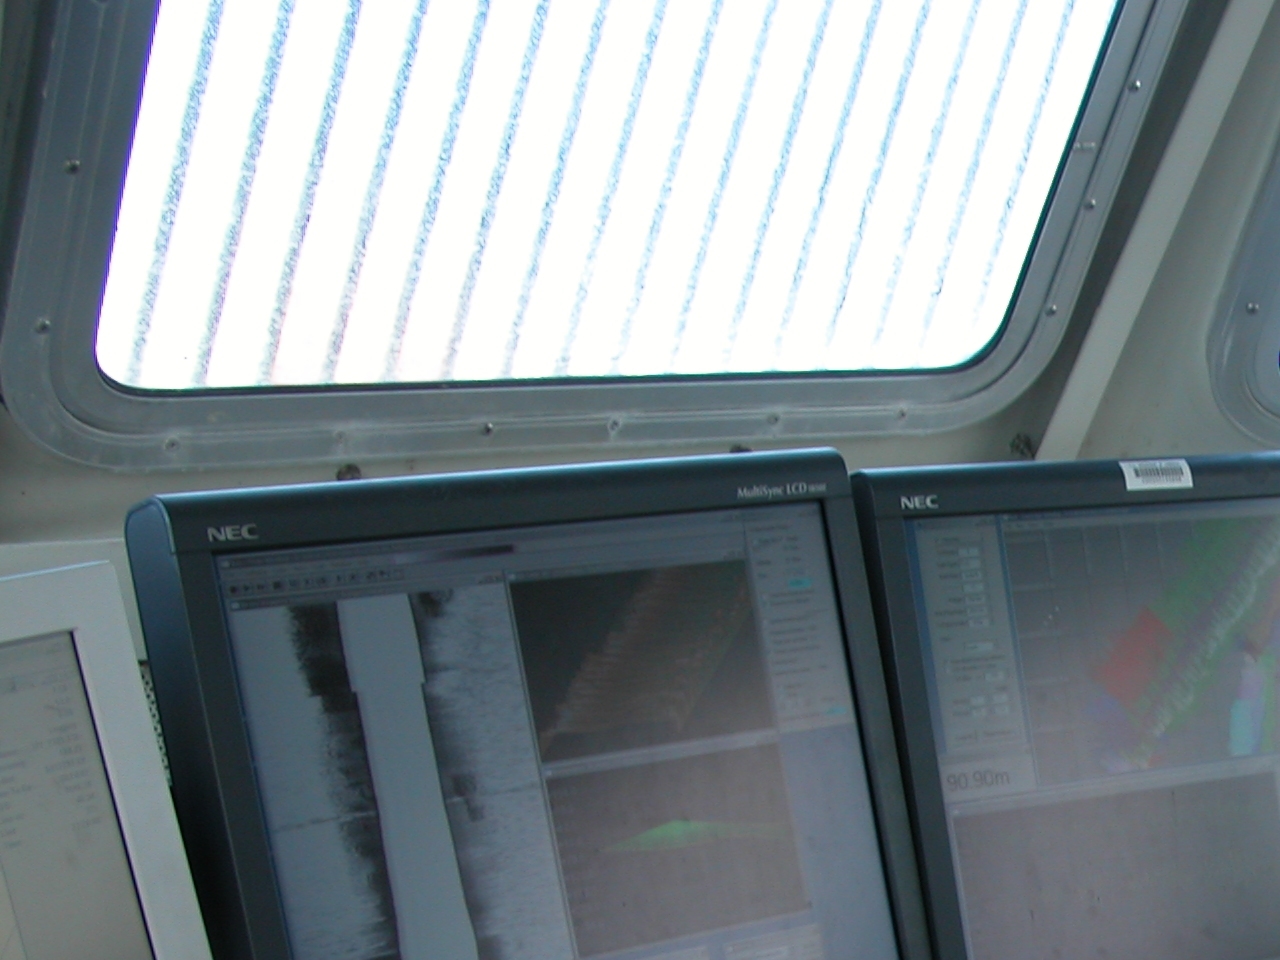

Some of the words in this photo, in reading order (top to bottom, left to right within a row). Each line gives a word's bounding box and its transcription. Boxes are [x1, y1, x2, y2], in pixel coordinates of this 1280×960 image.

[736, 483, 784, 500] MultiSync
[786, 482, 808, 496] LCD
[900, 494, 940, 511] NEC
[206, 523, 260, 543] NEC
[946, 769, 1011, 792] 90.90m
